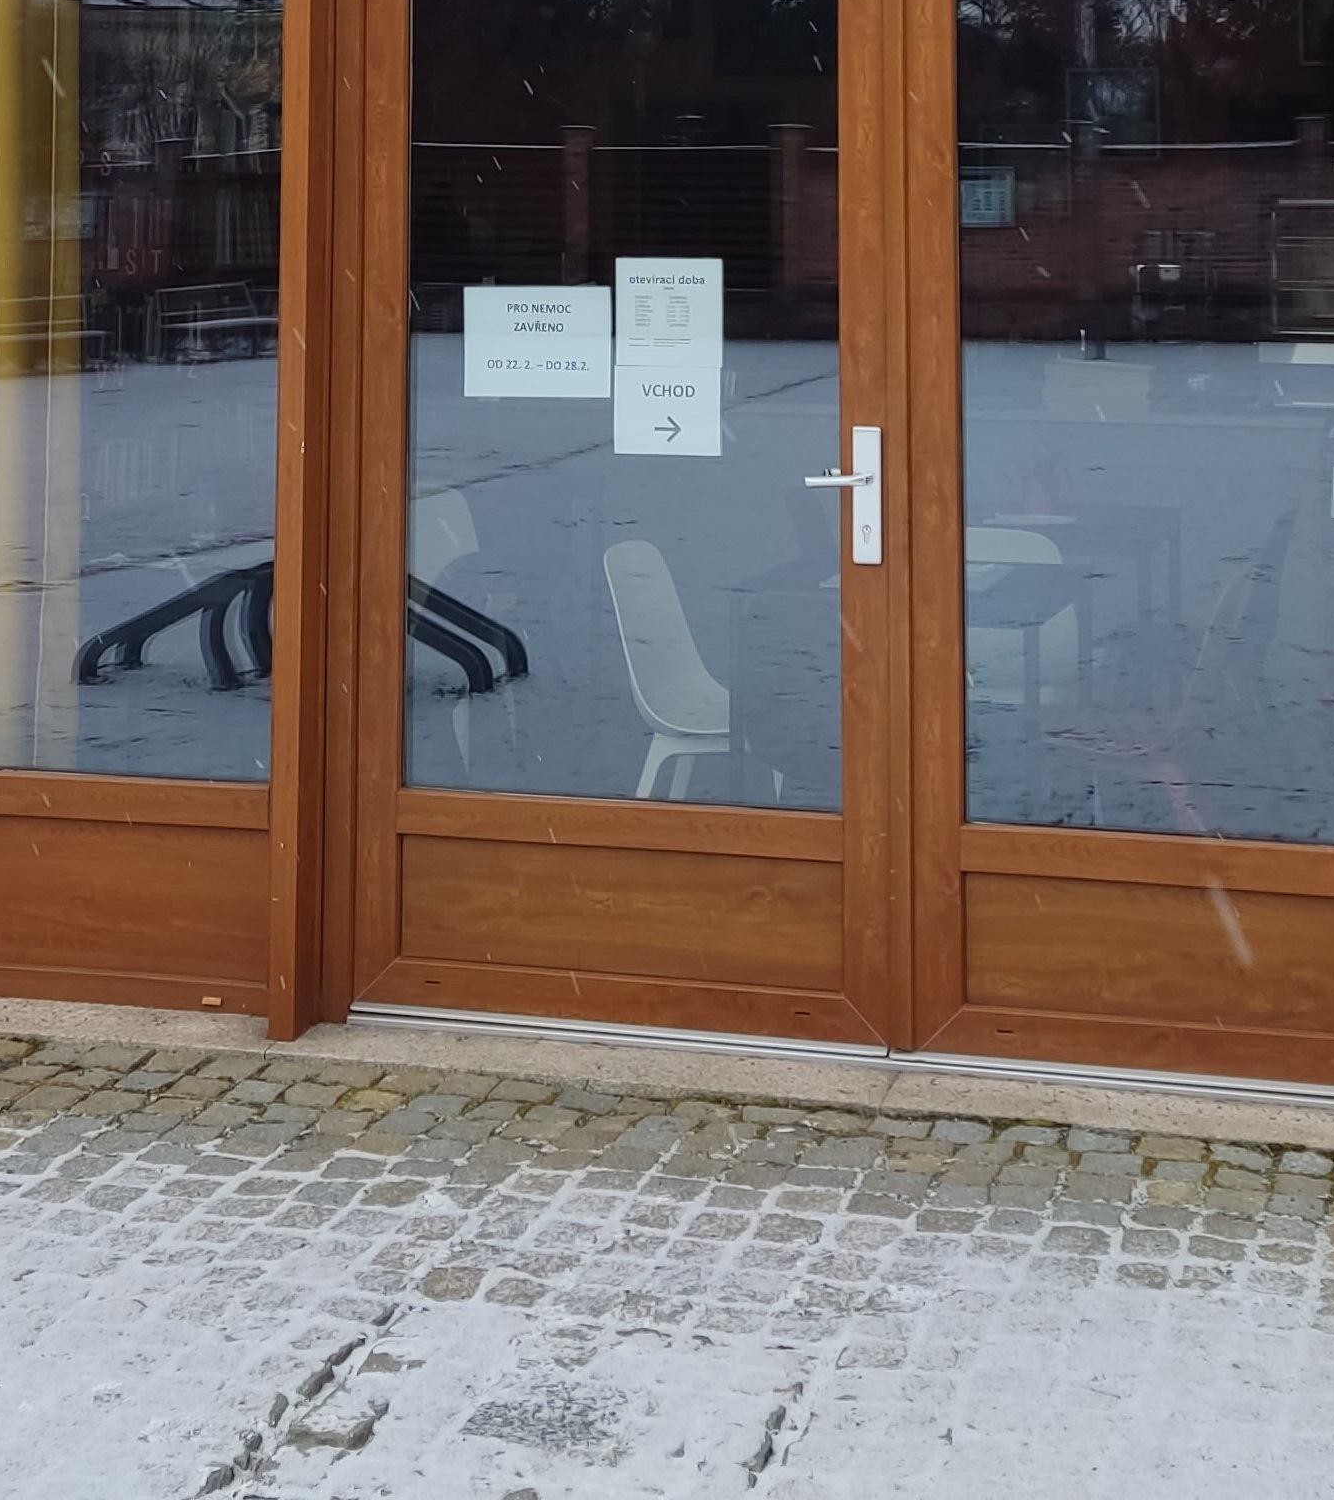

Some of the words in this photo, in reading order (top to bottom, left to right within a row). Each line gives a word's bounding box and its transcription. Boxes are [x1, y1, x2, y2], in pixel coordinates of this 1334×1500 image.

[677, 274, 706, 285] doba
[506, 303, 529, 314] PRO
[531, 303, 572, 315] NEMOC
[513, 320, 565, 333] ZAVŘENO
[486, 359, 504, 370] OD
[545, 360, 563, 371] DO
[641, 383, 696, 398] VCHOD
